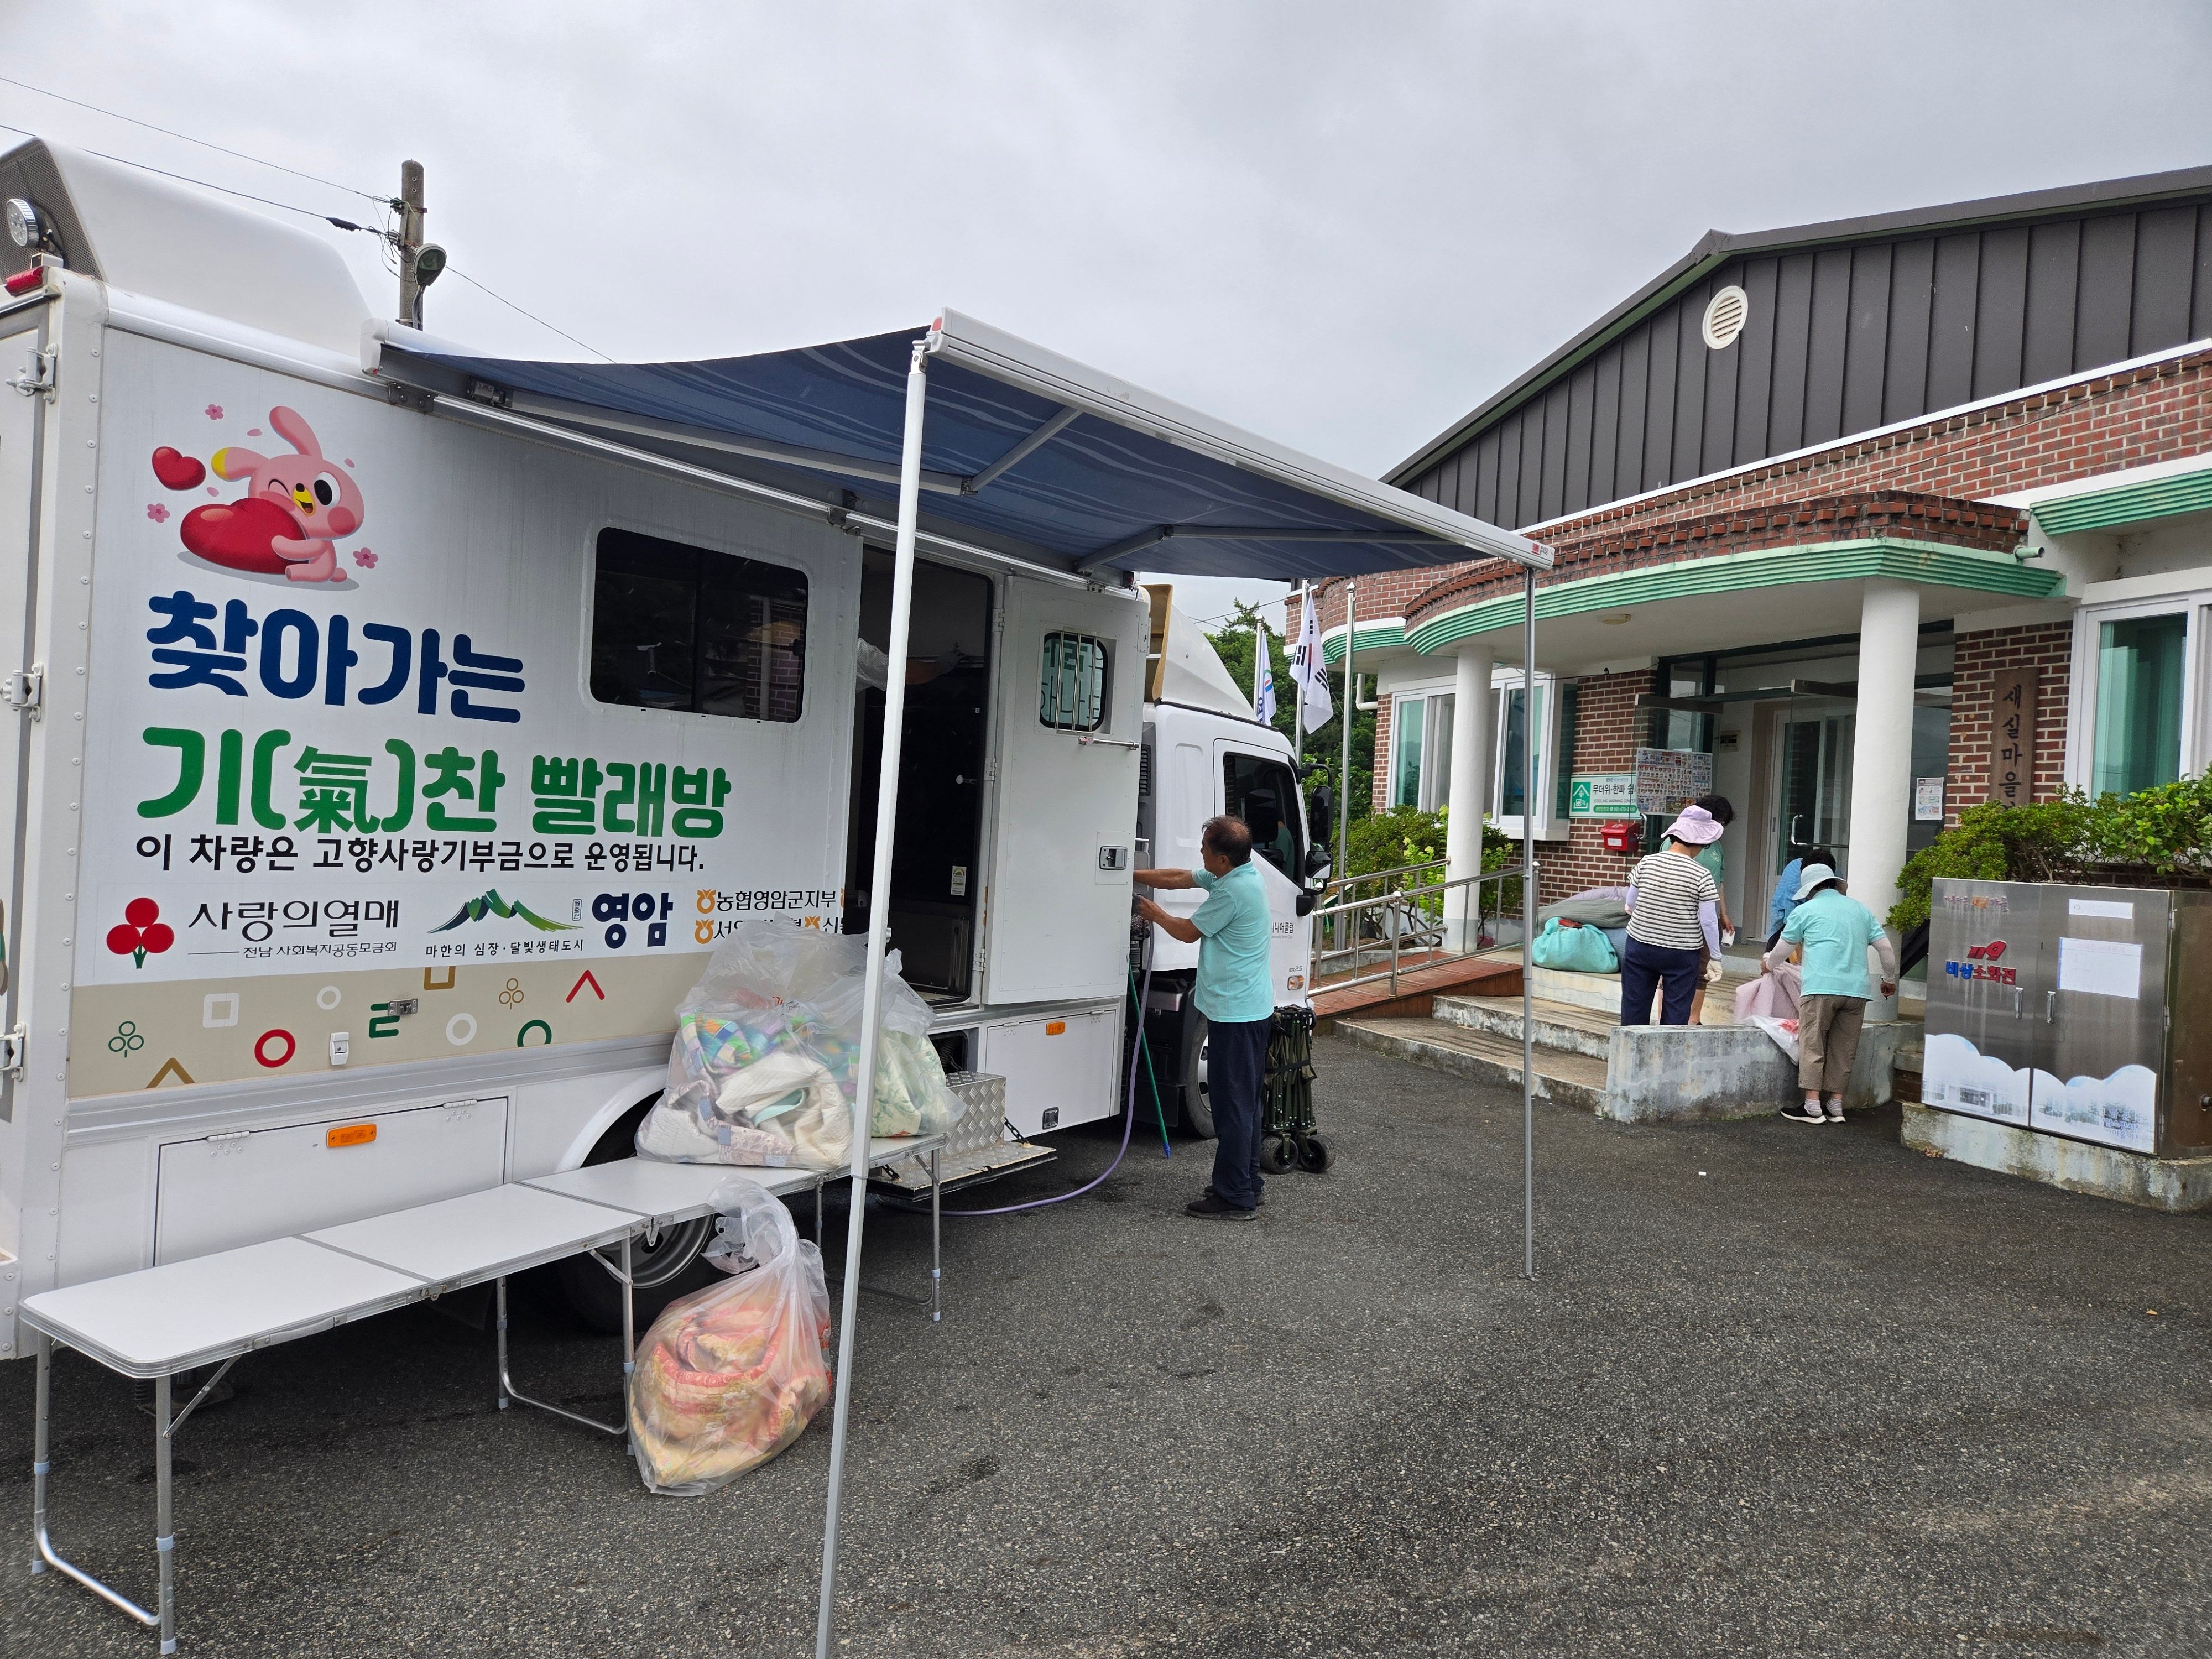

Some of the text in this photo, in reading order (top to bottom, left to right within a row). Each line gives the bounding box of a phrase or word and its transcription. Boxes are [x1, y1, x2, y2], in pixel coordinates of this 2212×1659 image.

[147, 591, 525, 723] 찾아가는
[1998, 684, 2023, 811] 새실마을
[137, 727, 732, 839] 기(氣)찬 빨래방
[1627, 784, 1636, 795] 쉼
[136, 834, 705, 874] 이 차량은 고향사랑기부금으로 운영됩니다.
[716, 890, 836, 912] 농협영암군지부
[188, 900, 399, 942] 사랑의열매
[592, 892, 674, 950] 영암
[243, 941, 397, 959] 전남 사회복지공동모금회
[425, 943, 466, 958] 마한의
[1966, 940, 2007, 961] 119
[1946, 960, 2017, 985] 비상소화전
